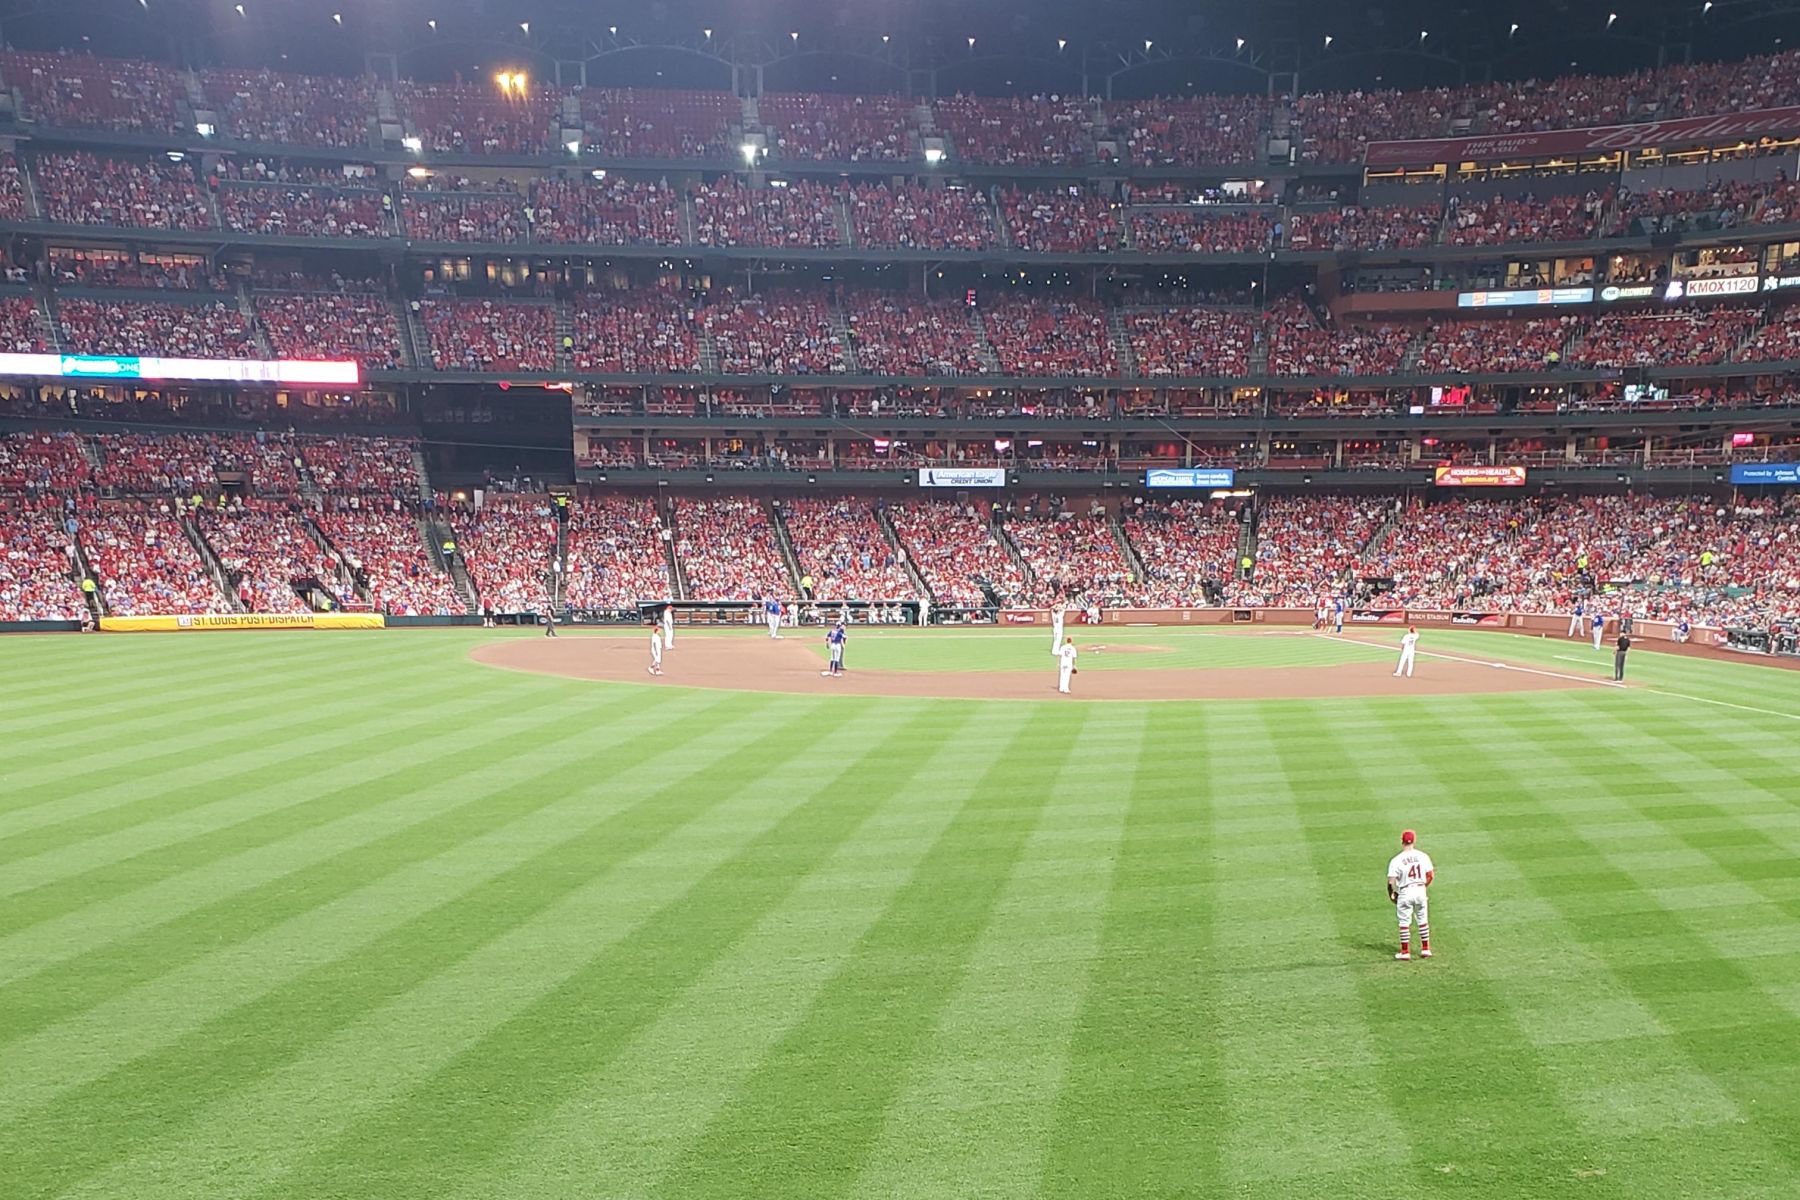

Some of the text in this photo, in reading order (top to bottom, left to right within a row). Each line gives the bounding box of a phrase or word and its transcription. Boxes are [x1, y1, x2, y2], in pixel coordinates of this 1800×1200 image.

[1466, 137, 1538, 149] THIS BUD'S
[1461, 148, 1488, 156] FOR
[1486, 468, 1511, 476] HEALTH
[193, 615, 315, 625] ST. LOUIS POST-DISPATCH
[1352, 613, 1380, 621] Safelite
[1452, 616, 1478, 624] Safelite
[1408, 864, 1422, 879] 41
